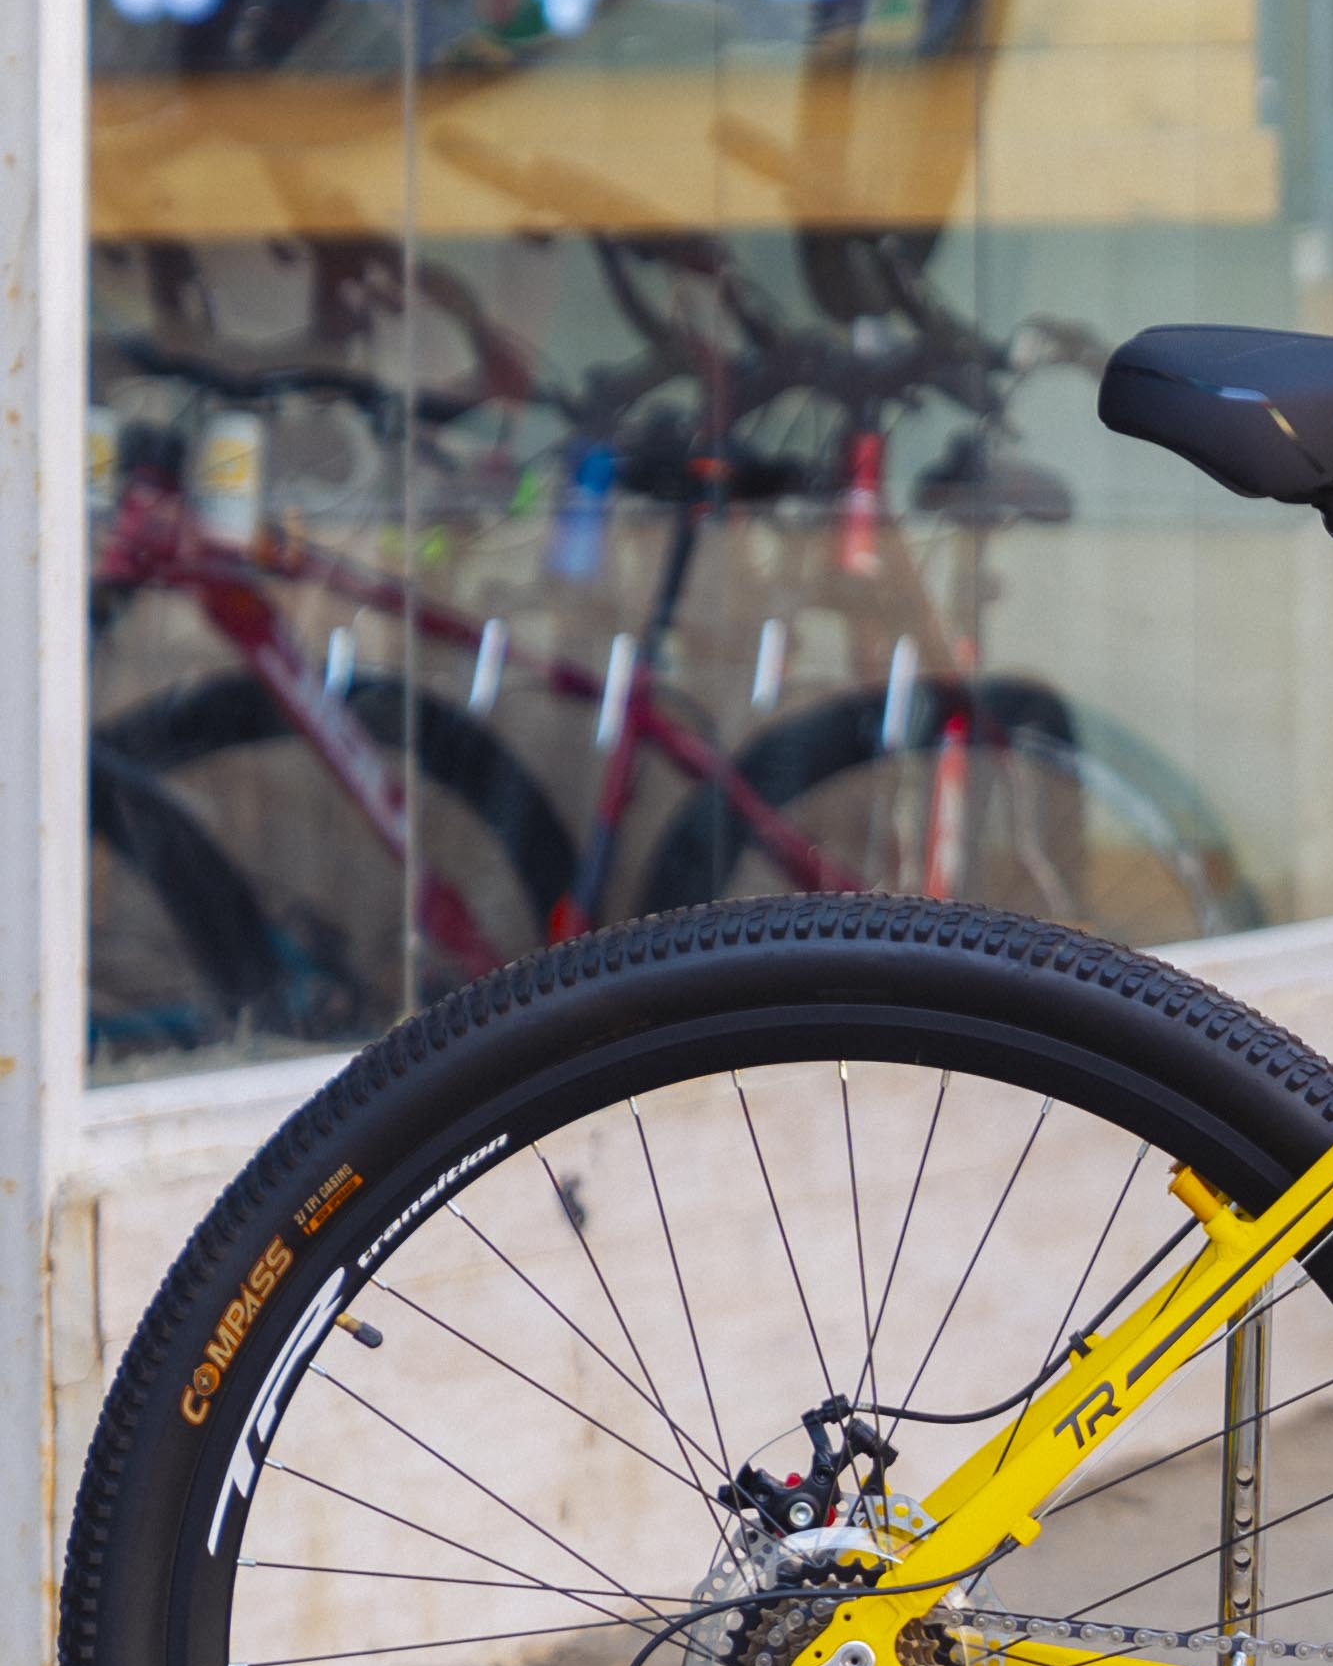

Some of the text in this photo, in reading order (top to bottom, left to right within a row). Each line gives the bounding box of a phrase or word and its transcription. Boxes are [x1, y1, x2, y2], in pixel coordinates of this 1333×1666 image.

[180, 1235, 294, 1426] COMPASS
[206, 1132, 510, 1558] TR transition
[1053, 1380, 1122, 1450] TR
